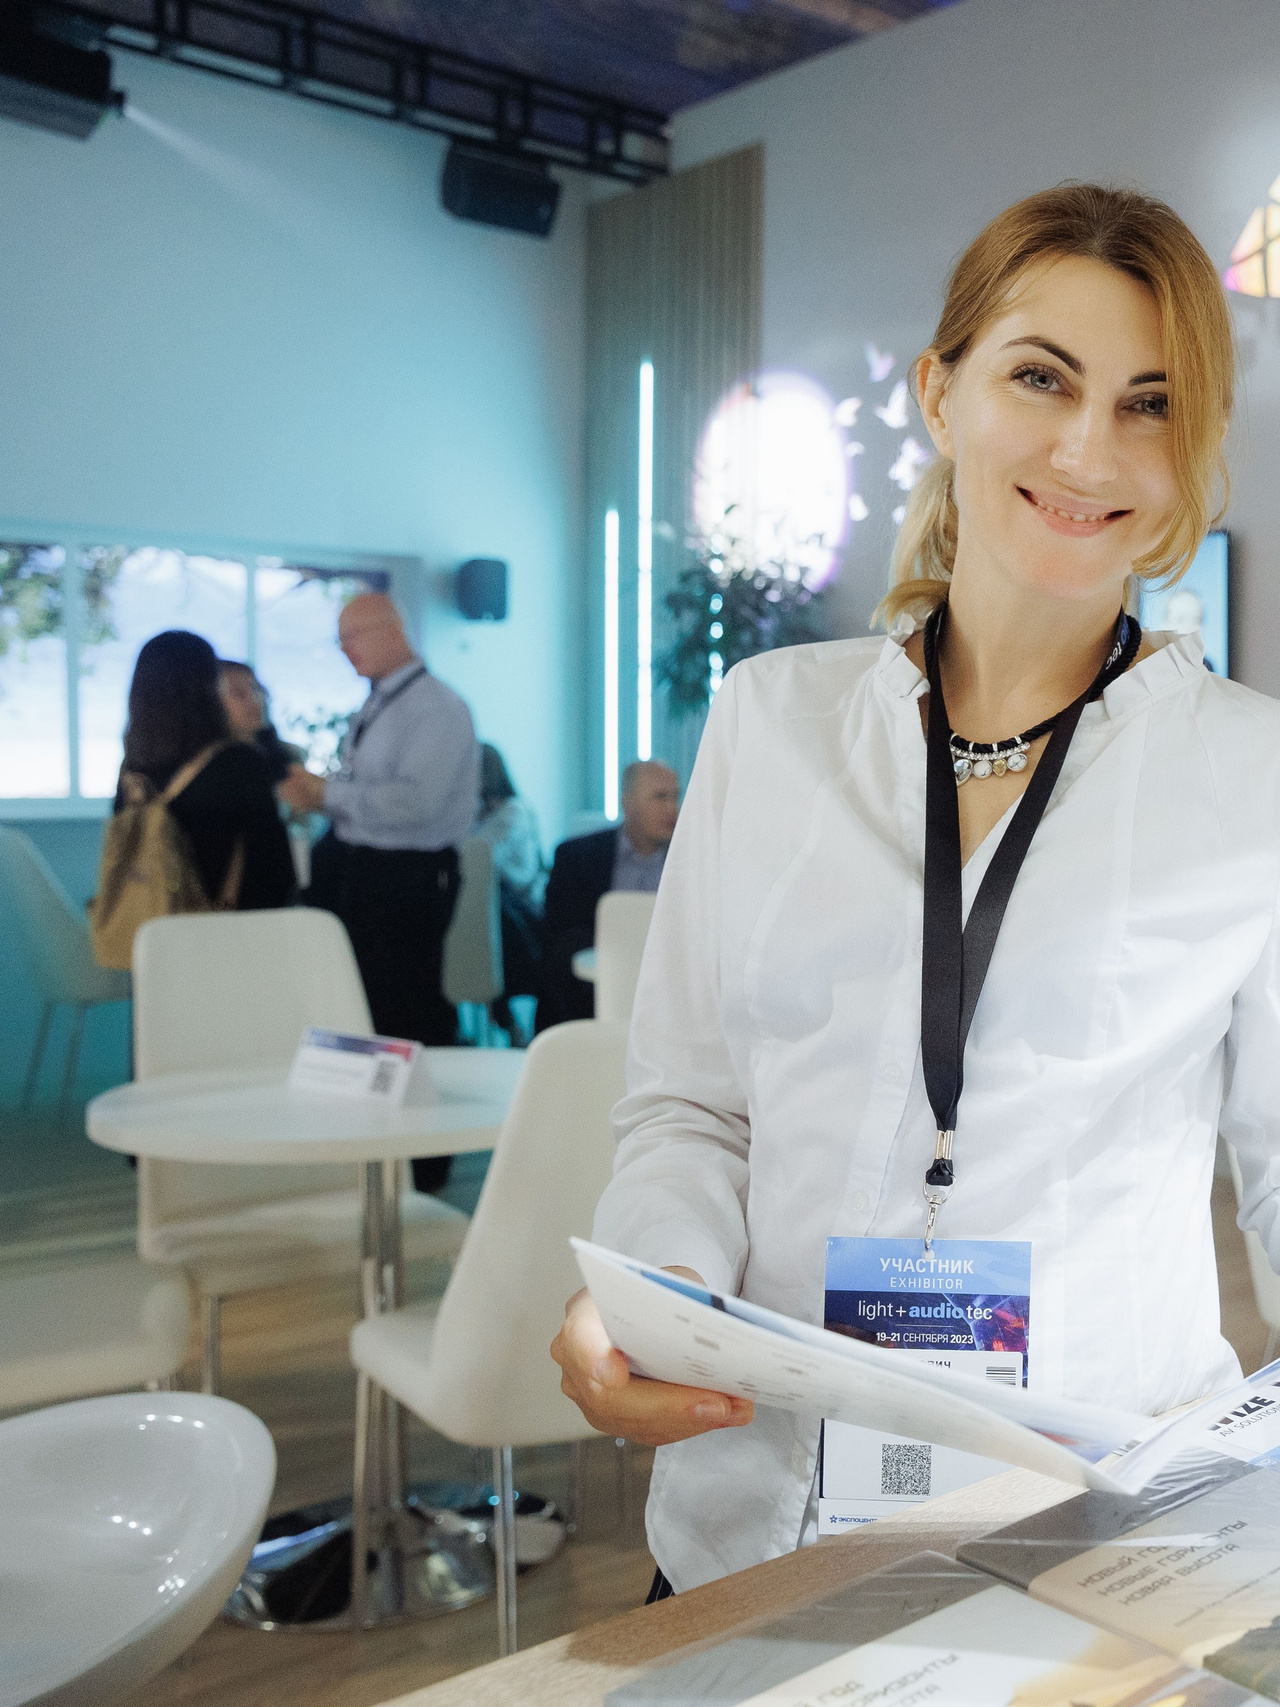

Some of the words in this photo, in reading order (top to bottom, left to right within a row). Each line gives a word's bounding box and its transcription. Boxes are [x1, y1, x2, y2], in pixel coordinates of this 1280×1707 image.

[880, 1257, 975, 1275] УЧАСТНИК
[890, 1277, 963, 1290] EXHIBITOR
[858, 1300, 893, 1320] light
[908, 1302, 964, 1319] audio
[966, 1305, 993, 1320] tec
[903, 1333, 949, 1343] СЕНТЯБРЯ
[950, 1334, 974, 1344] 2023
[1077, 1555, 1138, 1588] НОВЫЙ
[1097, 1565, 1158, 1597] НОВЫЕ
[1118, 1574, 1177, 1605] НОВАЯ
[1174, 1543, 1240, 1577] ВЫСОТА
